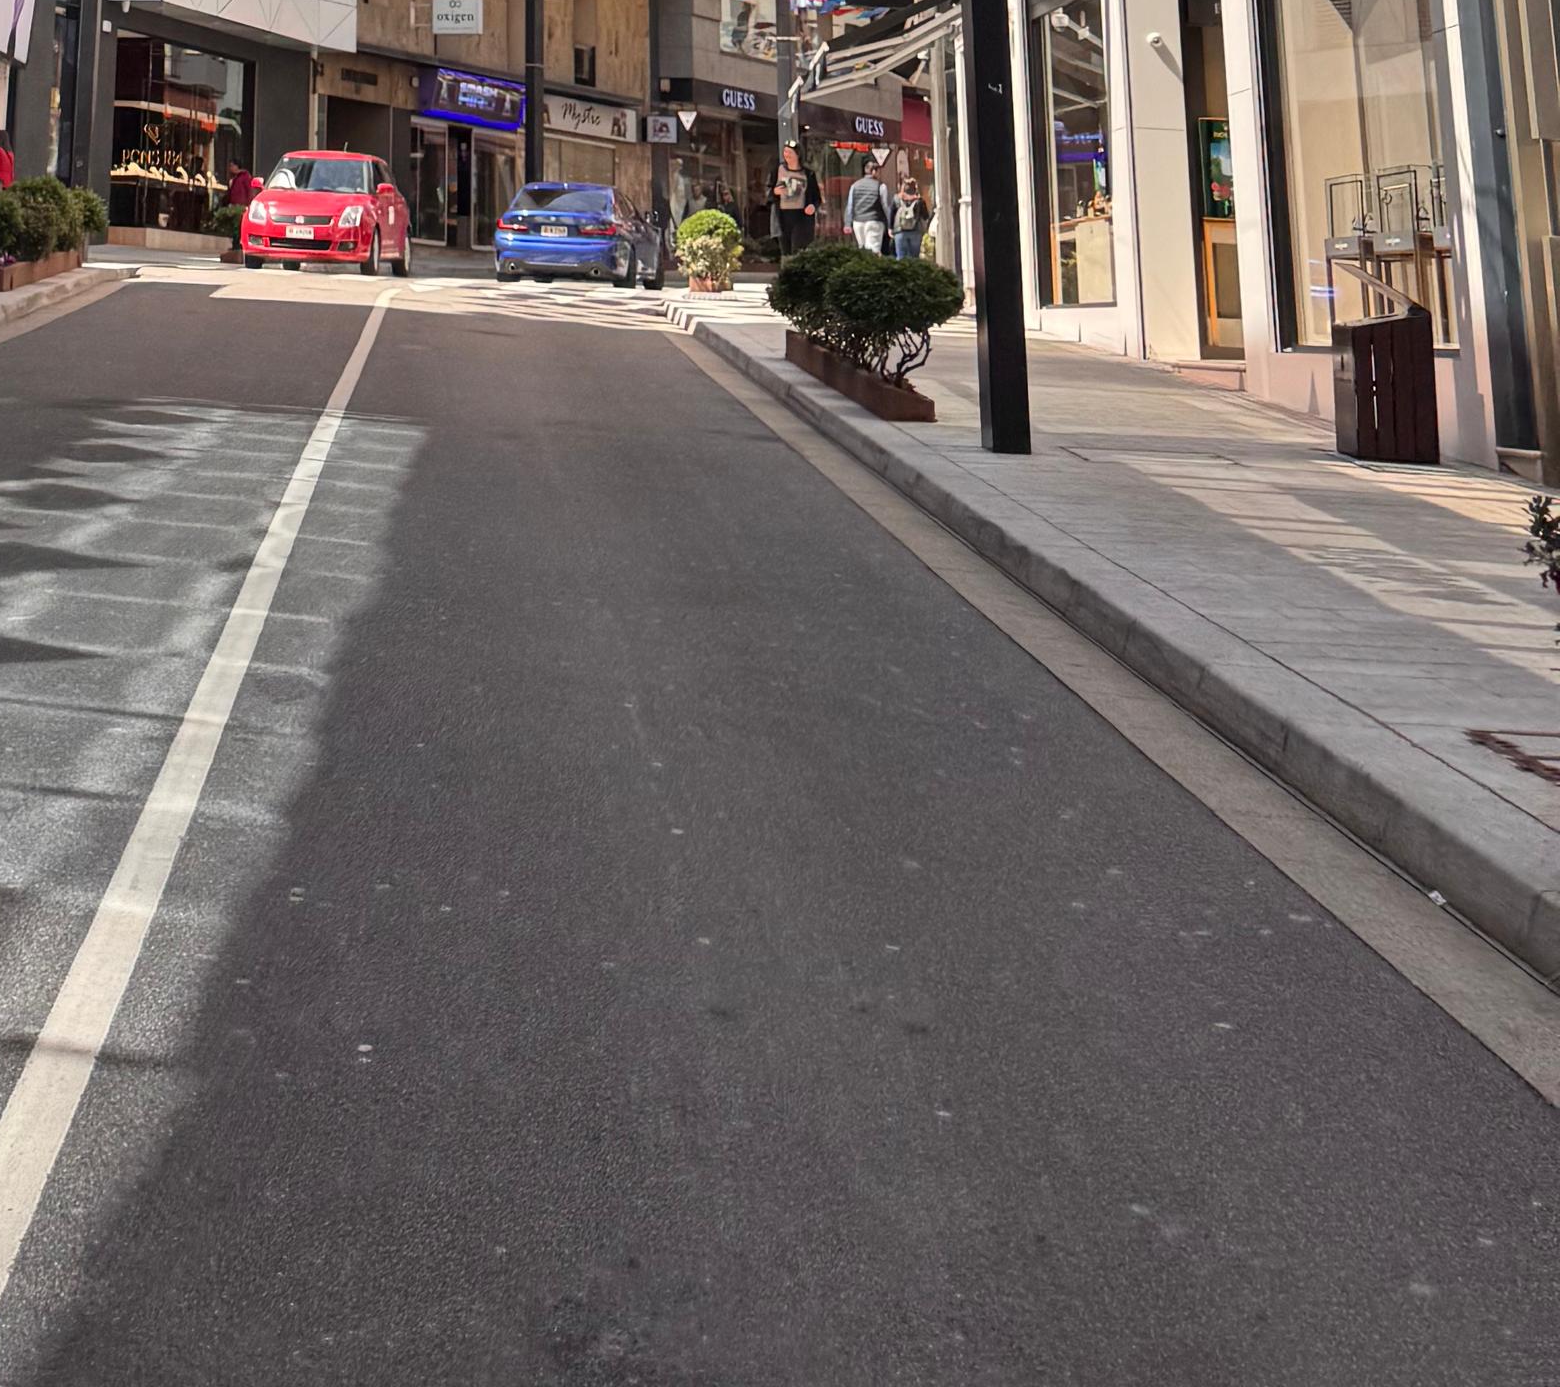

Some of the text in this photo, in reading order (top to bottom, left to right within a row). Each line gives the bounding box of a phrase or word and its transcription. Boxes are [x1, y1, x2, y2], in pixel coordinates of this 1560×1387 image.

[437, 10, 475, 24] oxigen
[722, 88, 756, 112] GUESS
[855, 116, 884, 138] GUESS
